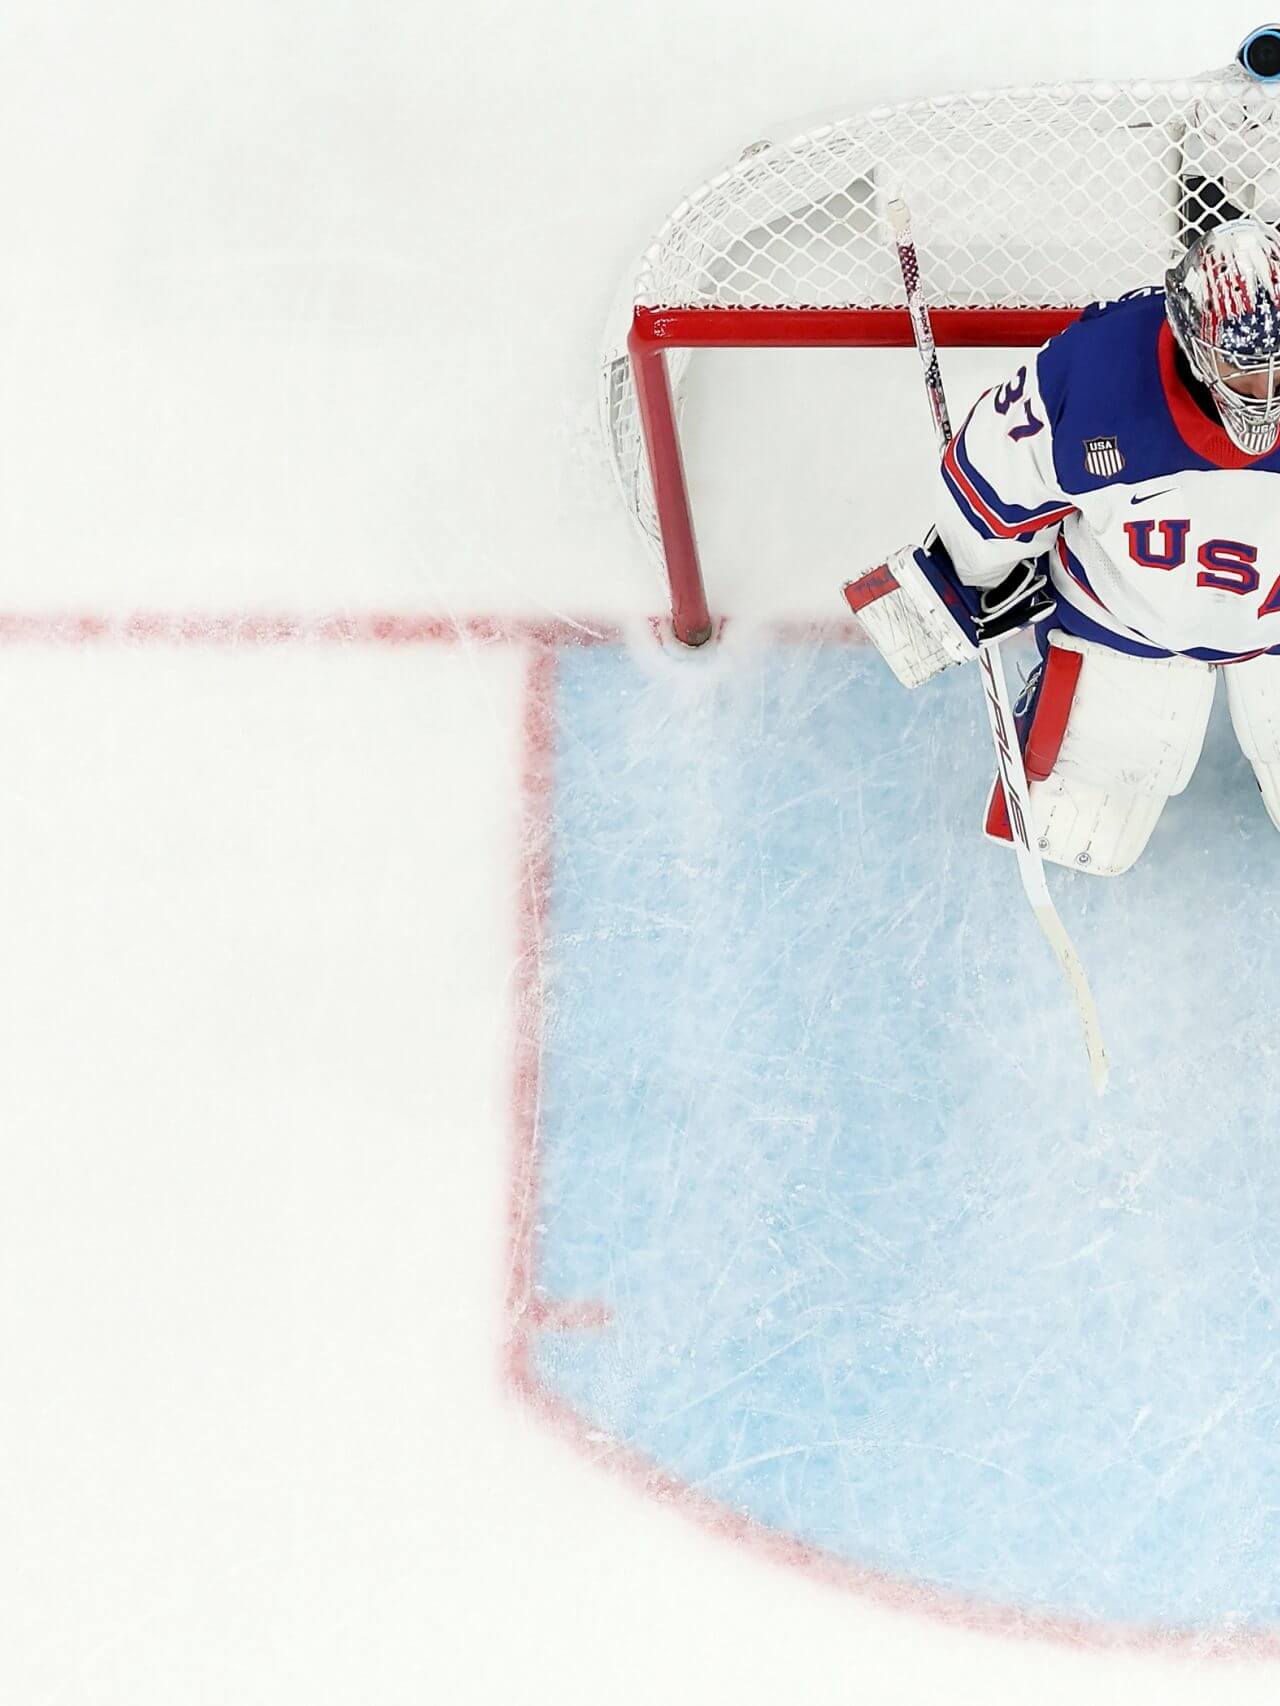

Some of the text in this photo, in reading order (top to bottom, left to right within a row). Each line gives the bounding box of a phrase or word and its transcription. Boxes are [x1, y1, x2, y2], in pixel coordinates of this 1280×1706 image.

[994, 366, 1044, 442] 37
[1251, 422, 1276, 433] USA
[1089, 440, 1113, 451] USA
